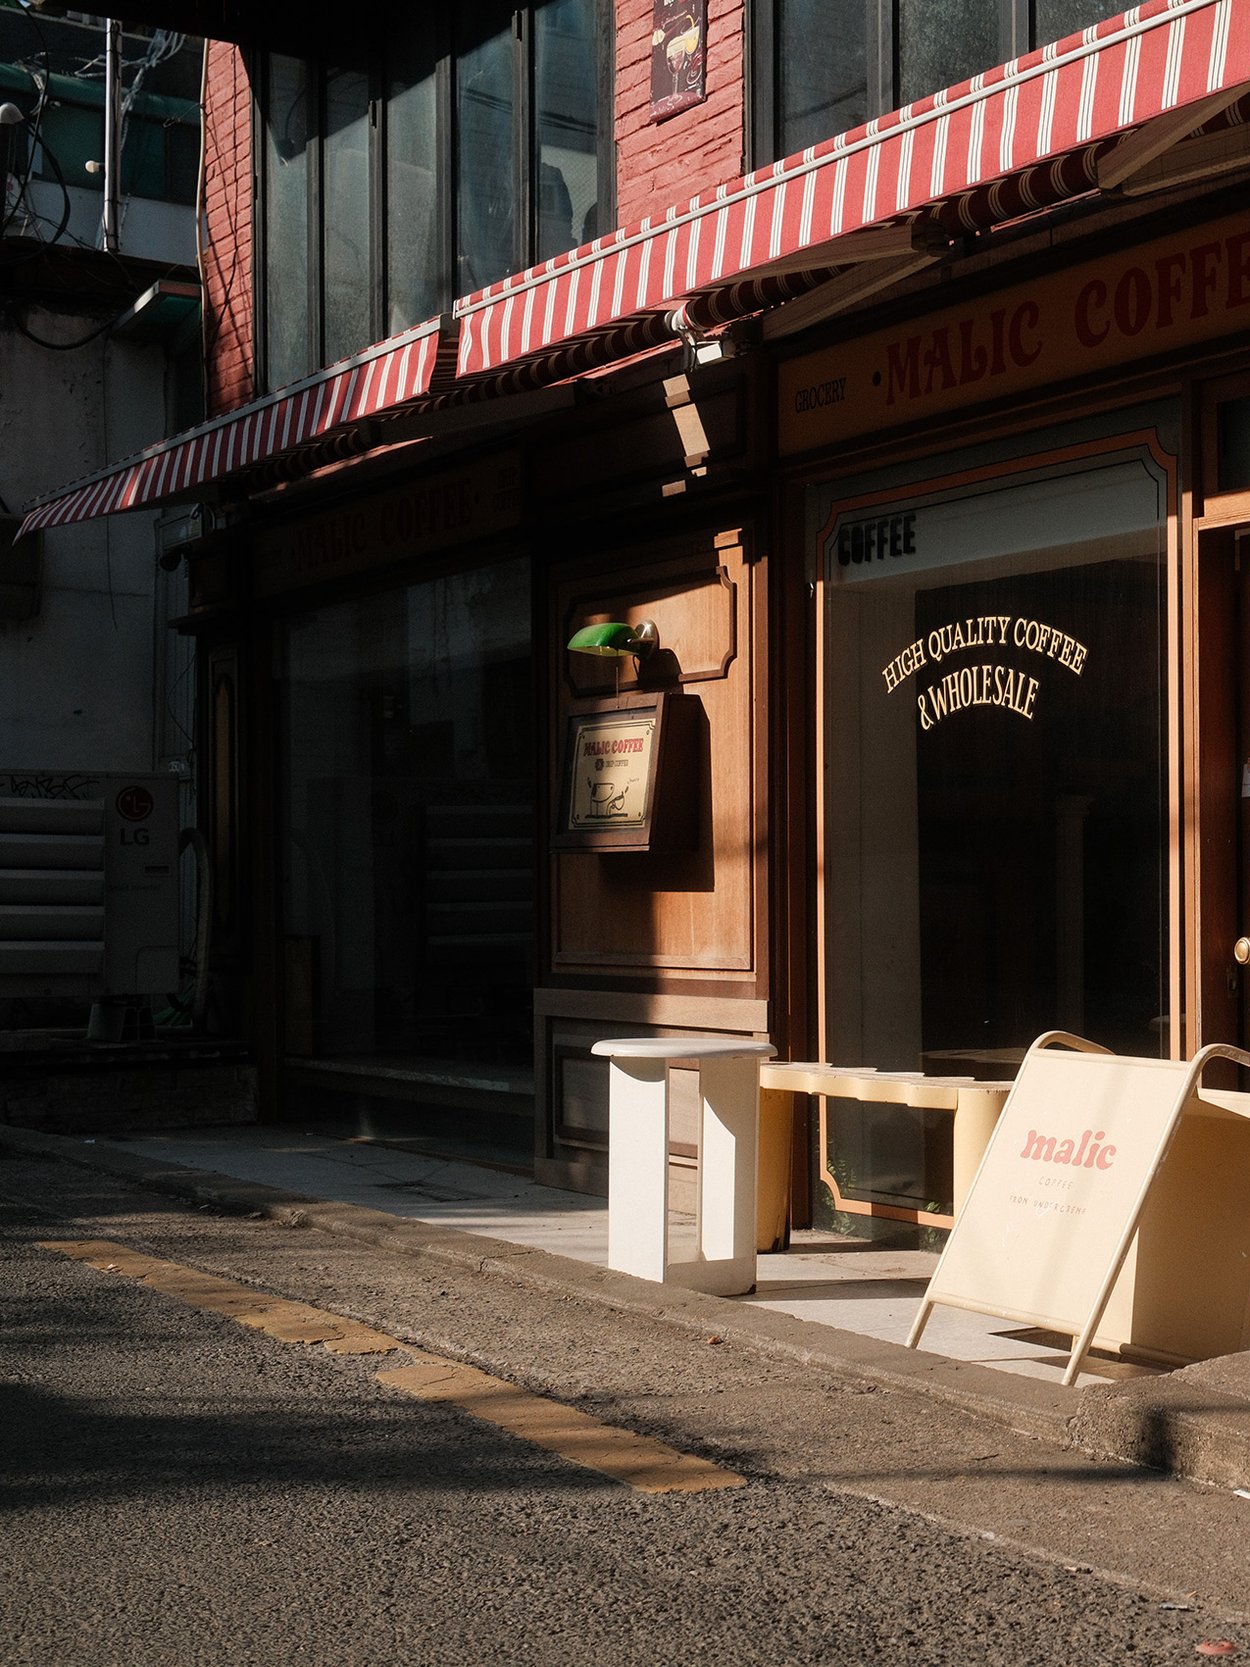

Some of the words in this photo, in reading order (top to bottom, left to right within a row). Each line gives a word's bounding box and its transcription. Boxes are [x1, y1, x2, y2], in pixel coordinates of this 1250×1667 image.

[885, 301, 1044, 406] MALIC
[795, 376, 846, 415] GROCERY
[838, 514, 917, 567] COFFEE
[882, 638, 927, 694] HIGH
[928, 616, 1010, 662] QUALITY
[1014, 617, 1088, 676] COFFEE
[917, 694, 935, 731] &
[928, 665, 1040, 722] WHOLESALE
[583, 740, 610, 757] MALIC
[611, 737, 644, 755] COFFEE
[120, 828, 149, 845] LG
[1020, 1129, 1117, 1171] malic
[1008, 1194, 1028, 1206] FROM
[1038, 1176, 1074, 1190] COFFEE
